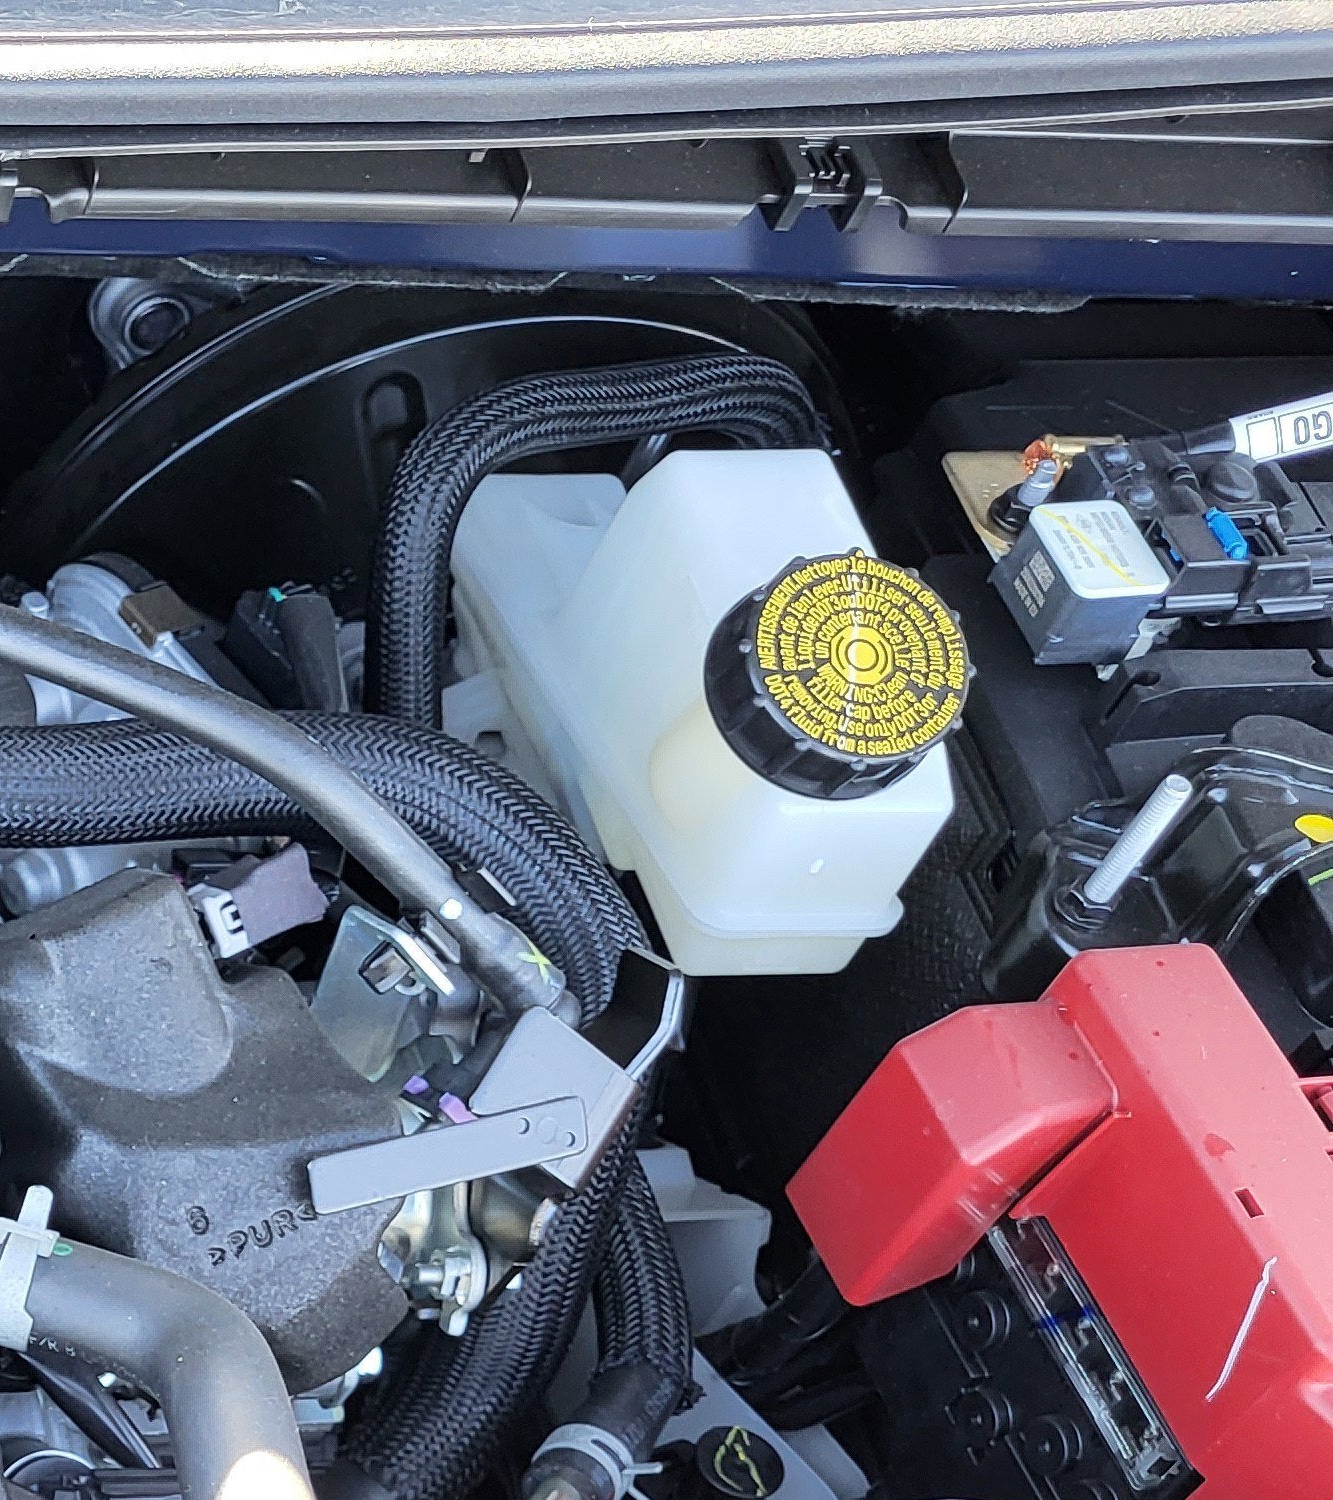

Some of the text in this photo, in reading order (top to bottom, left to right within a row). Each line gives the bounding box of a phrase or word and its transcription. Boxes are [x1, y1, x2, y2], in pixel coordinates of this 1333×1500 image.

[846, 702, 870, 721] cap
[873, 690, 916, 719] before
[913, 693, 961, 745] container
